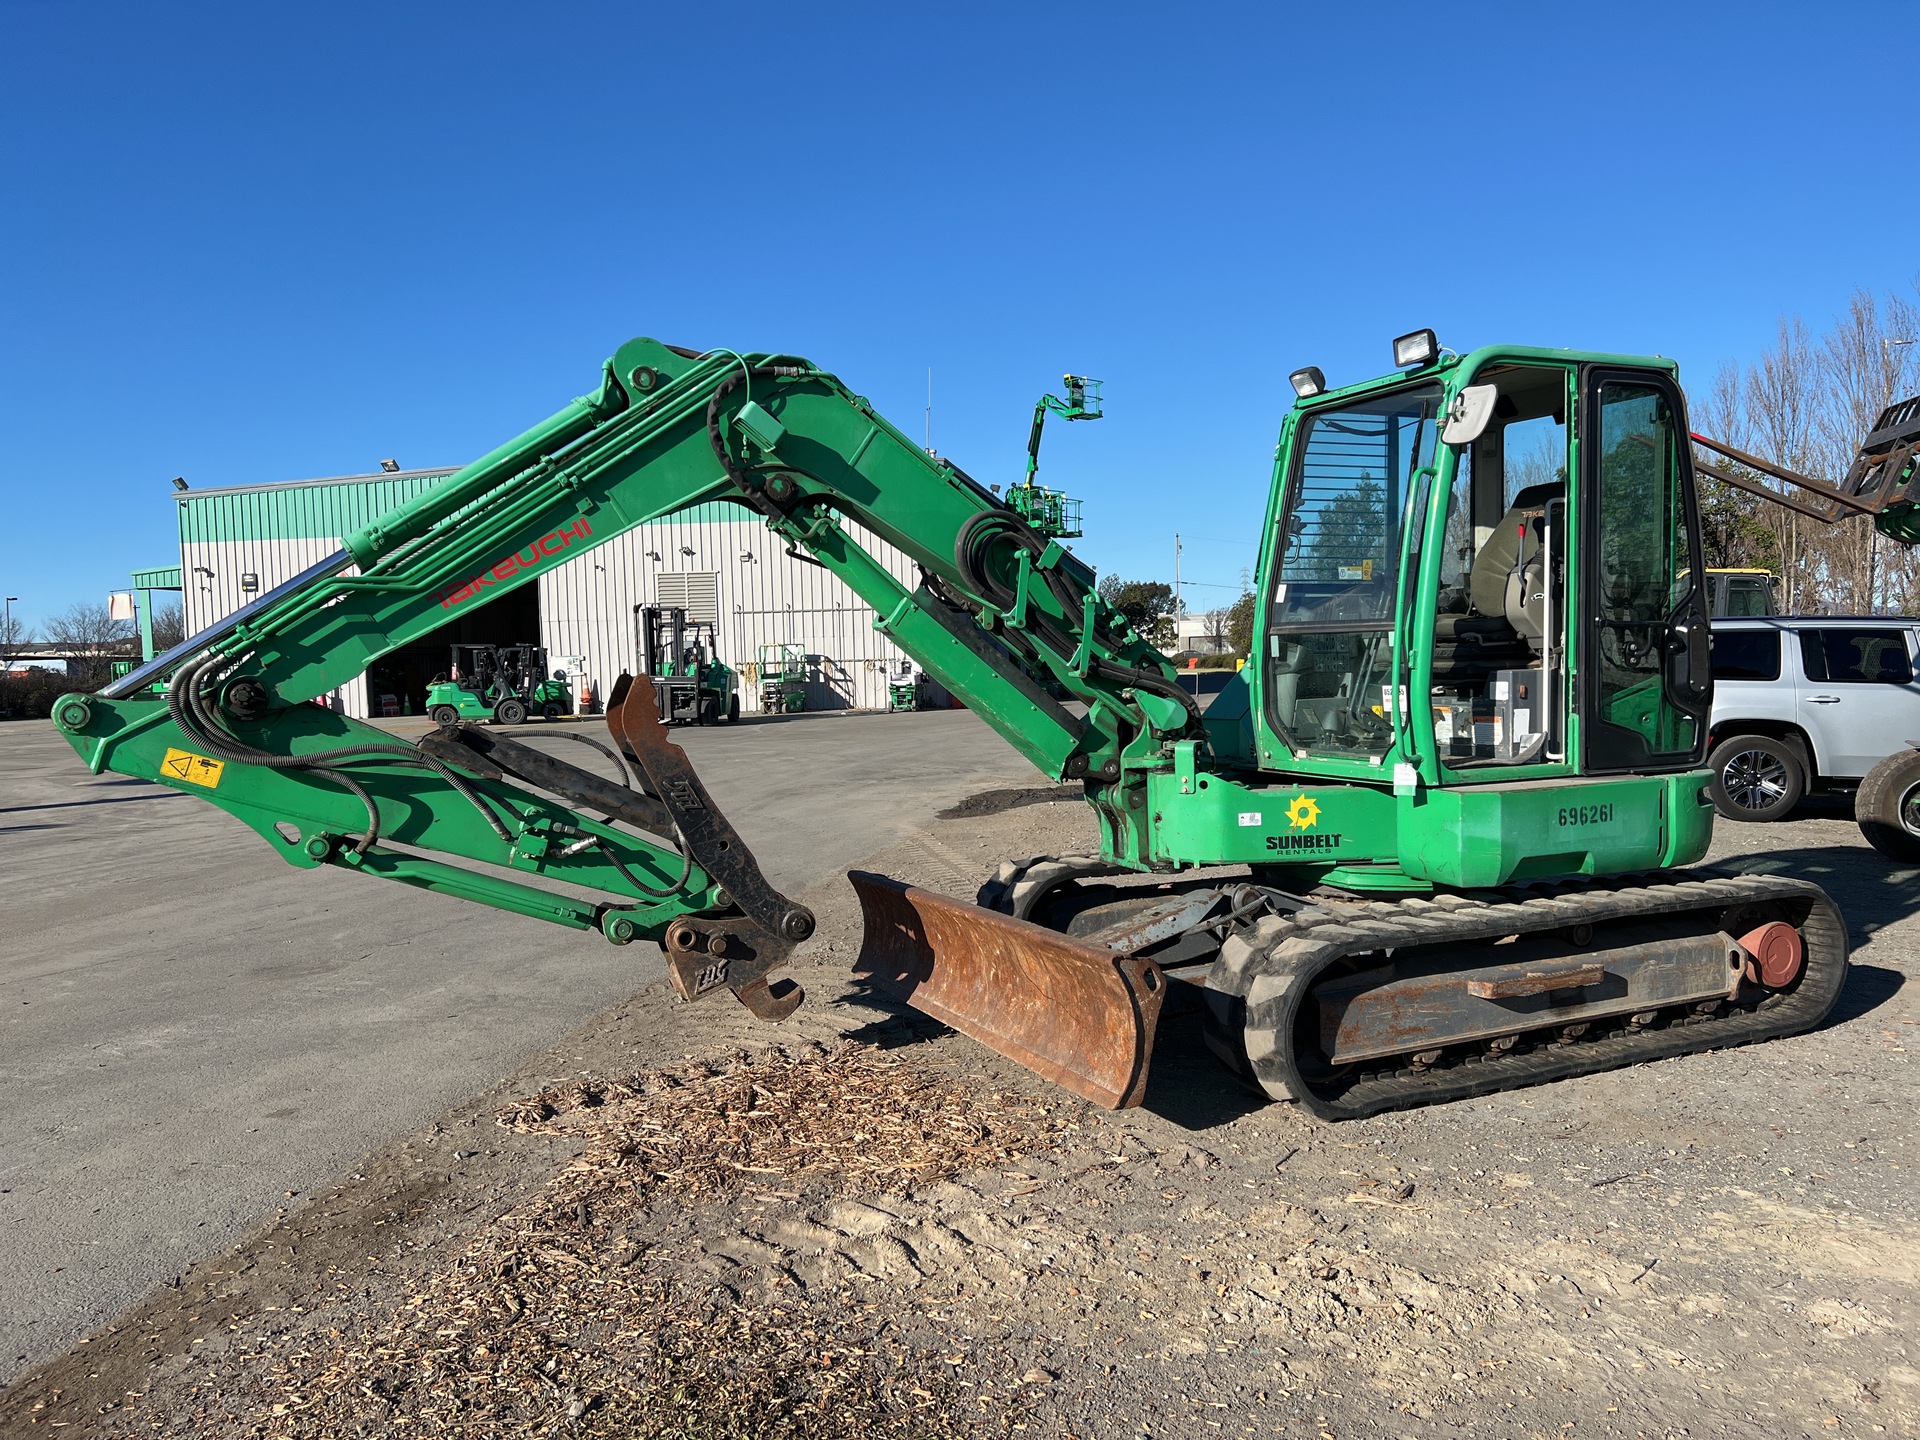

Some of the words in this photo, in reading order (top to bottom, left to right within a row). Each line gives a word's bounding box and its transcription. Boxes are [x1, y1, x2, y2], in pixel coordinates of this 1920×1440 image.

[1558, 803, 1614, 827] 696261
[1265, 833, 1342, 851] SUNBELT
[1276, 847, 1332, 856] RENTALS
